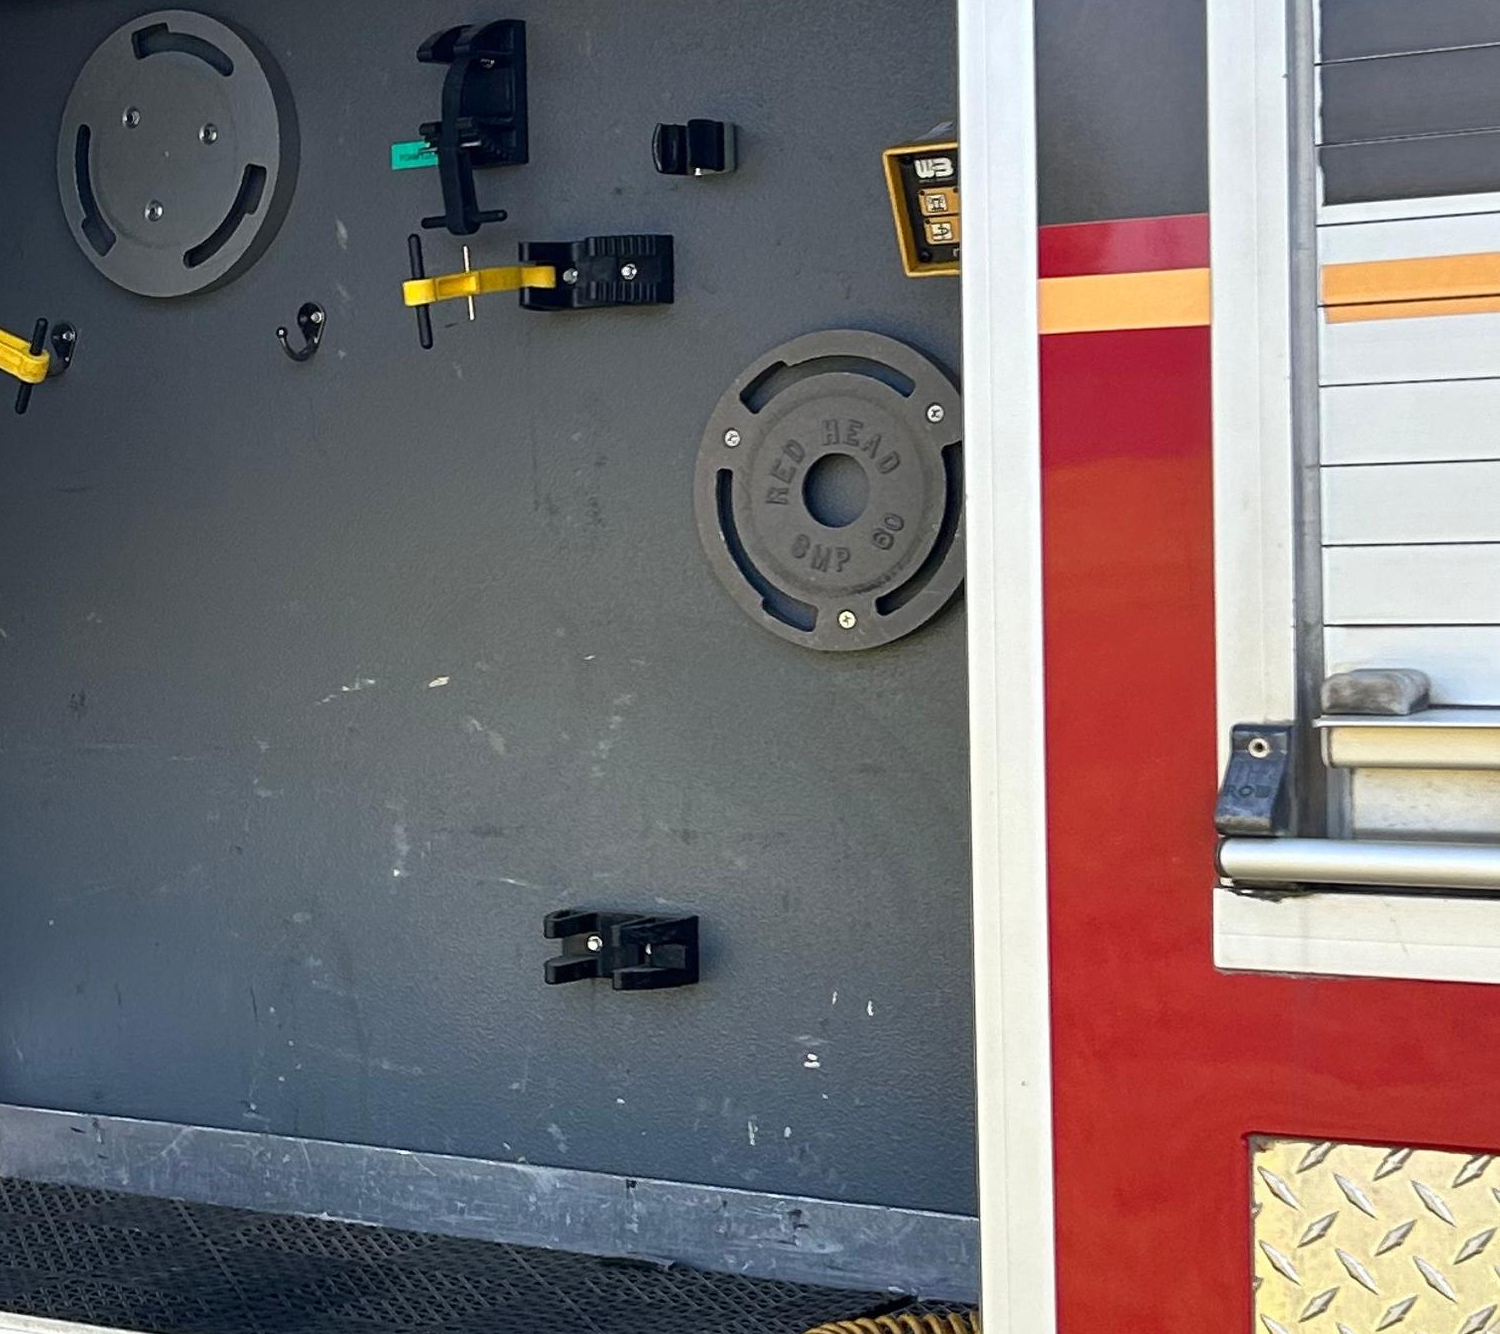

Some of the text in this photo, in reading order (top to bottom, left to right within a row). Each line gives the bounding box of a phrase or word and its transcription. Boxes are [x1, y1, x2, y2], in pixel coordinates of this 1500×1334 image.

[766, 419, 900, 505] RED HEAD
[872, 513, 904, 550] 60
